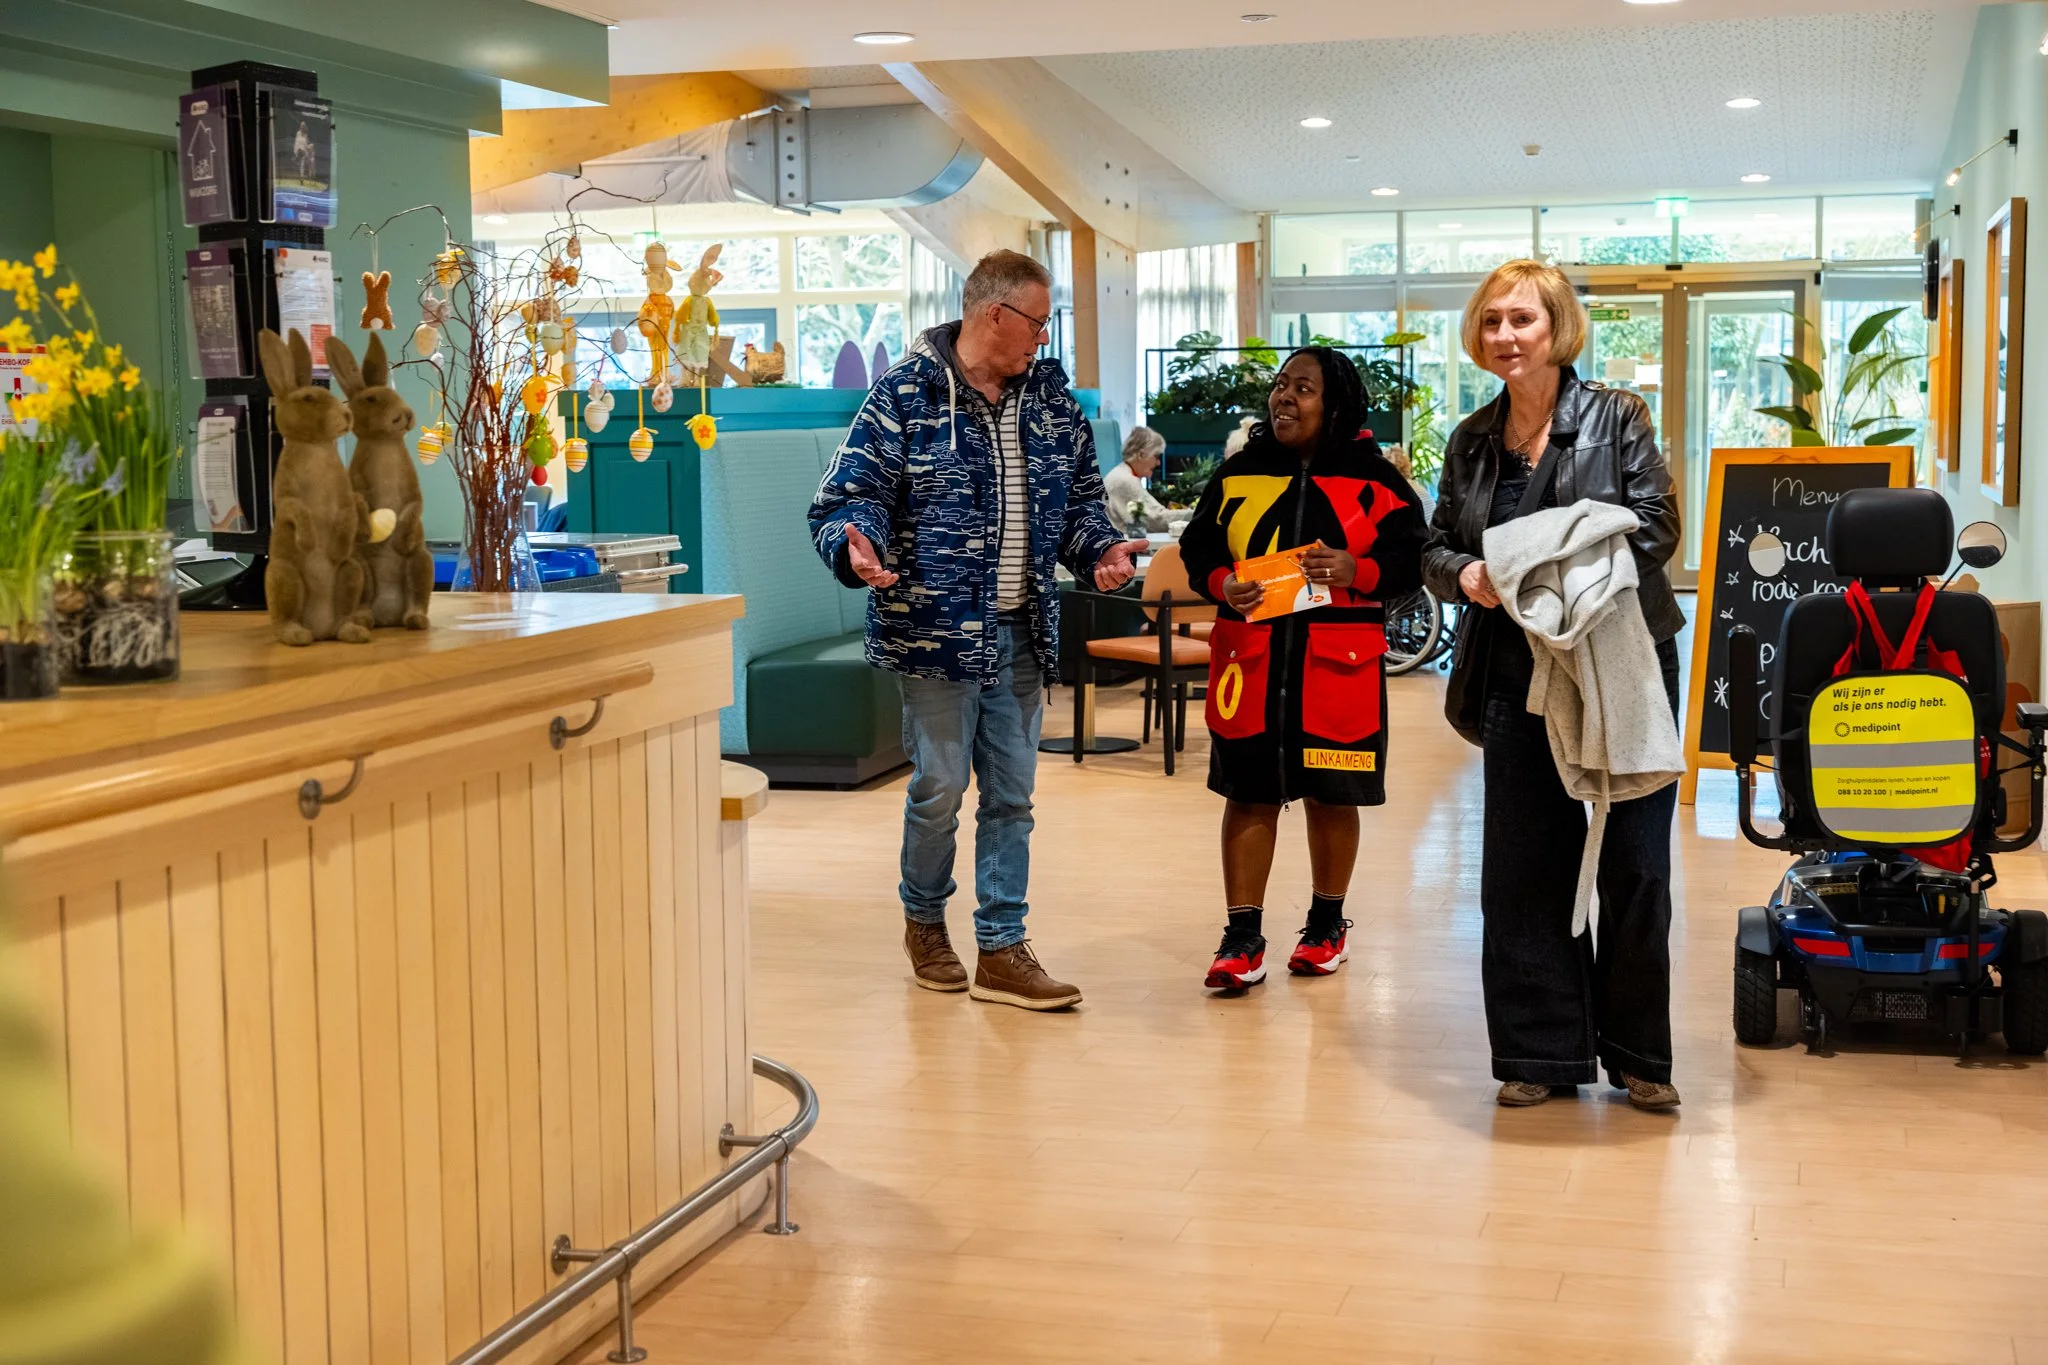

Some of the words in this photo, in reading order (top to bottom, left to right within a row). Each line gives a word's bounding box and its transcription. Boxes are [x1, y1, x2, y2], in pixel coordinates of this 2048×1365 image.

[1772, 477, 1840, 507] Menu
[1752, 575, 1799, 602] rode
[1833, 688, 1850, 699] Wij
[1852, 686, 1871, 699] zijn
[1874, 687, 1885, 696] er
[1833, 701, 1849, 712] als
[1851, 700, 1861, 712] je
[1864, 701, 1884, 710] ons
[1886, 698, 1917, 710] nodig
[1919, 697, 1947, 707] hebt.
[1852, 722, 1901, 734] medipoint
[1308, 751, 1373, 769] LINKAIMENG
[1853, 788, 1862, 796] 10
[1863, 788, 1872, 796] 20
[1874, 788, 1887, 796] 100
[1895, 787, 1939, 796] medipoint.nl
